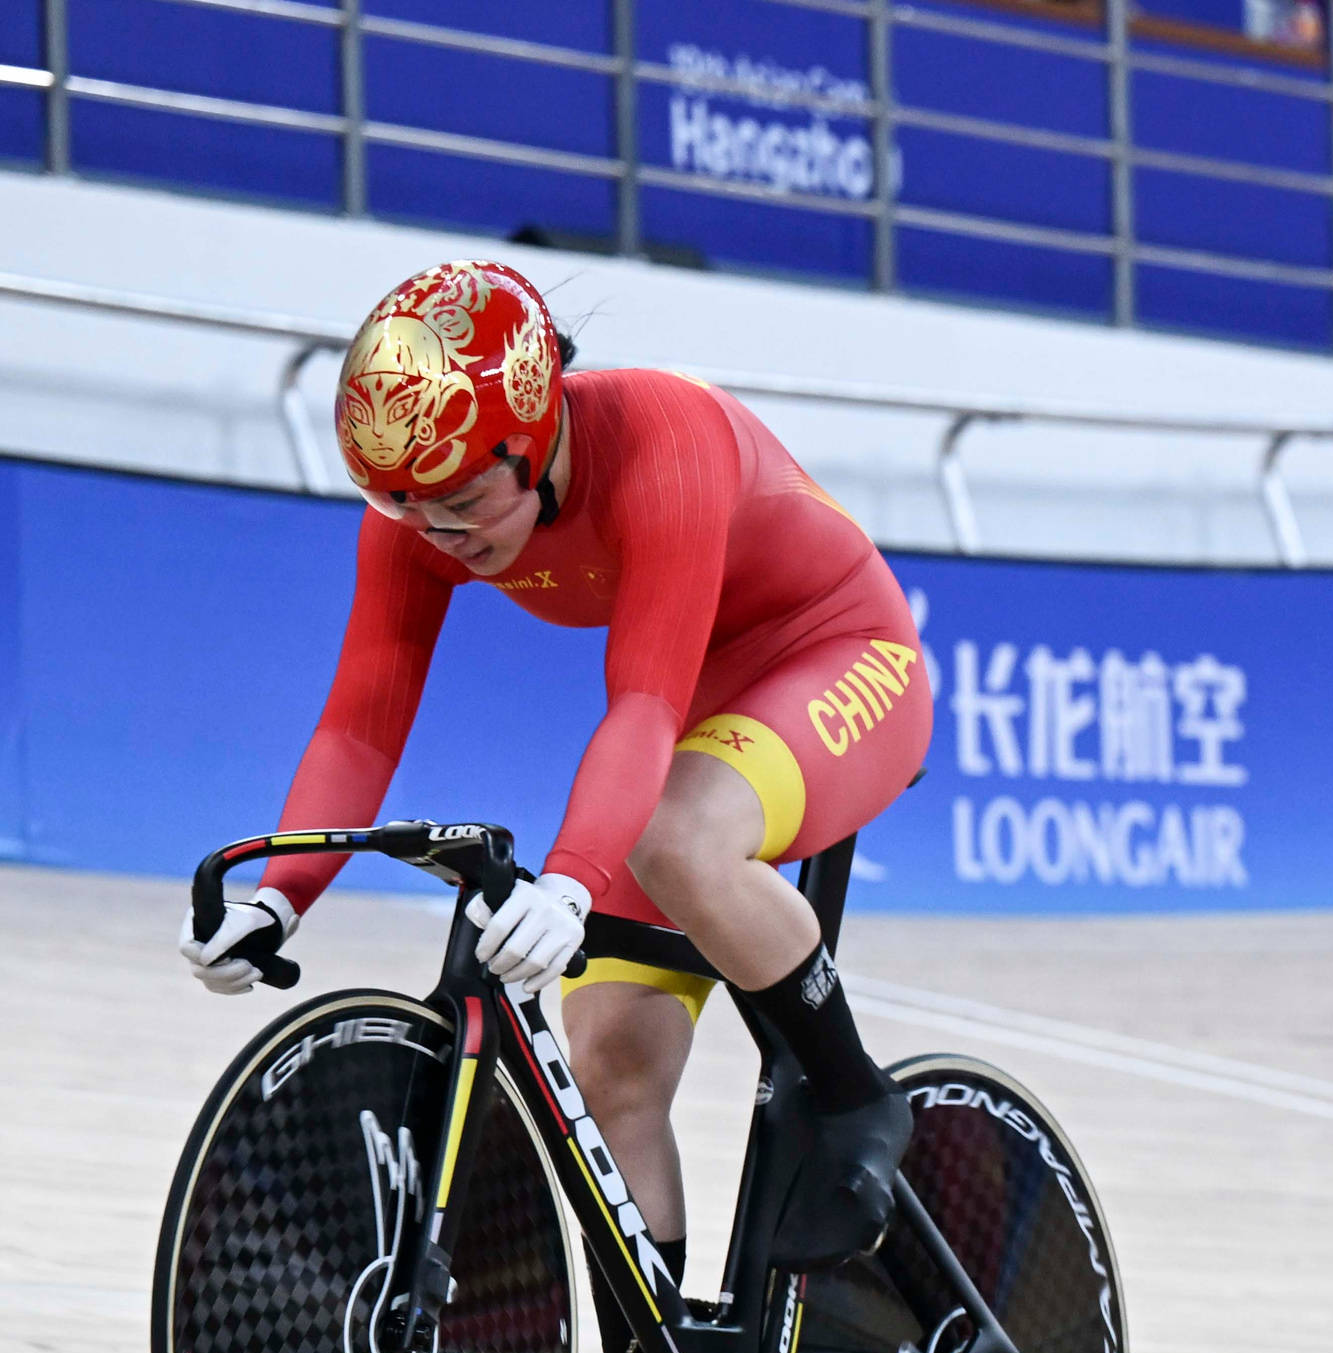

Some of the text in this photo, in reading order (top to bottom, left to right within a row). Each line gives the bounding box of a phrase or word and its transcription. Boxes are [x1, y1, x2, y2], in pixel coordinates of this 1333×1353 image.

[808, 639, 917, 757] CHINA
[952, 640, 1248, 787] 长龙航空
[428, 824, 487, 842] LOOK
[953, 797, 1248, 888] LOONGAIR
[502, 979, 680, 1297] LOOK
